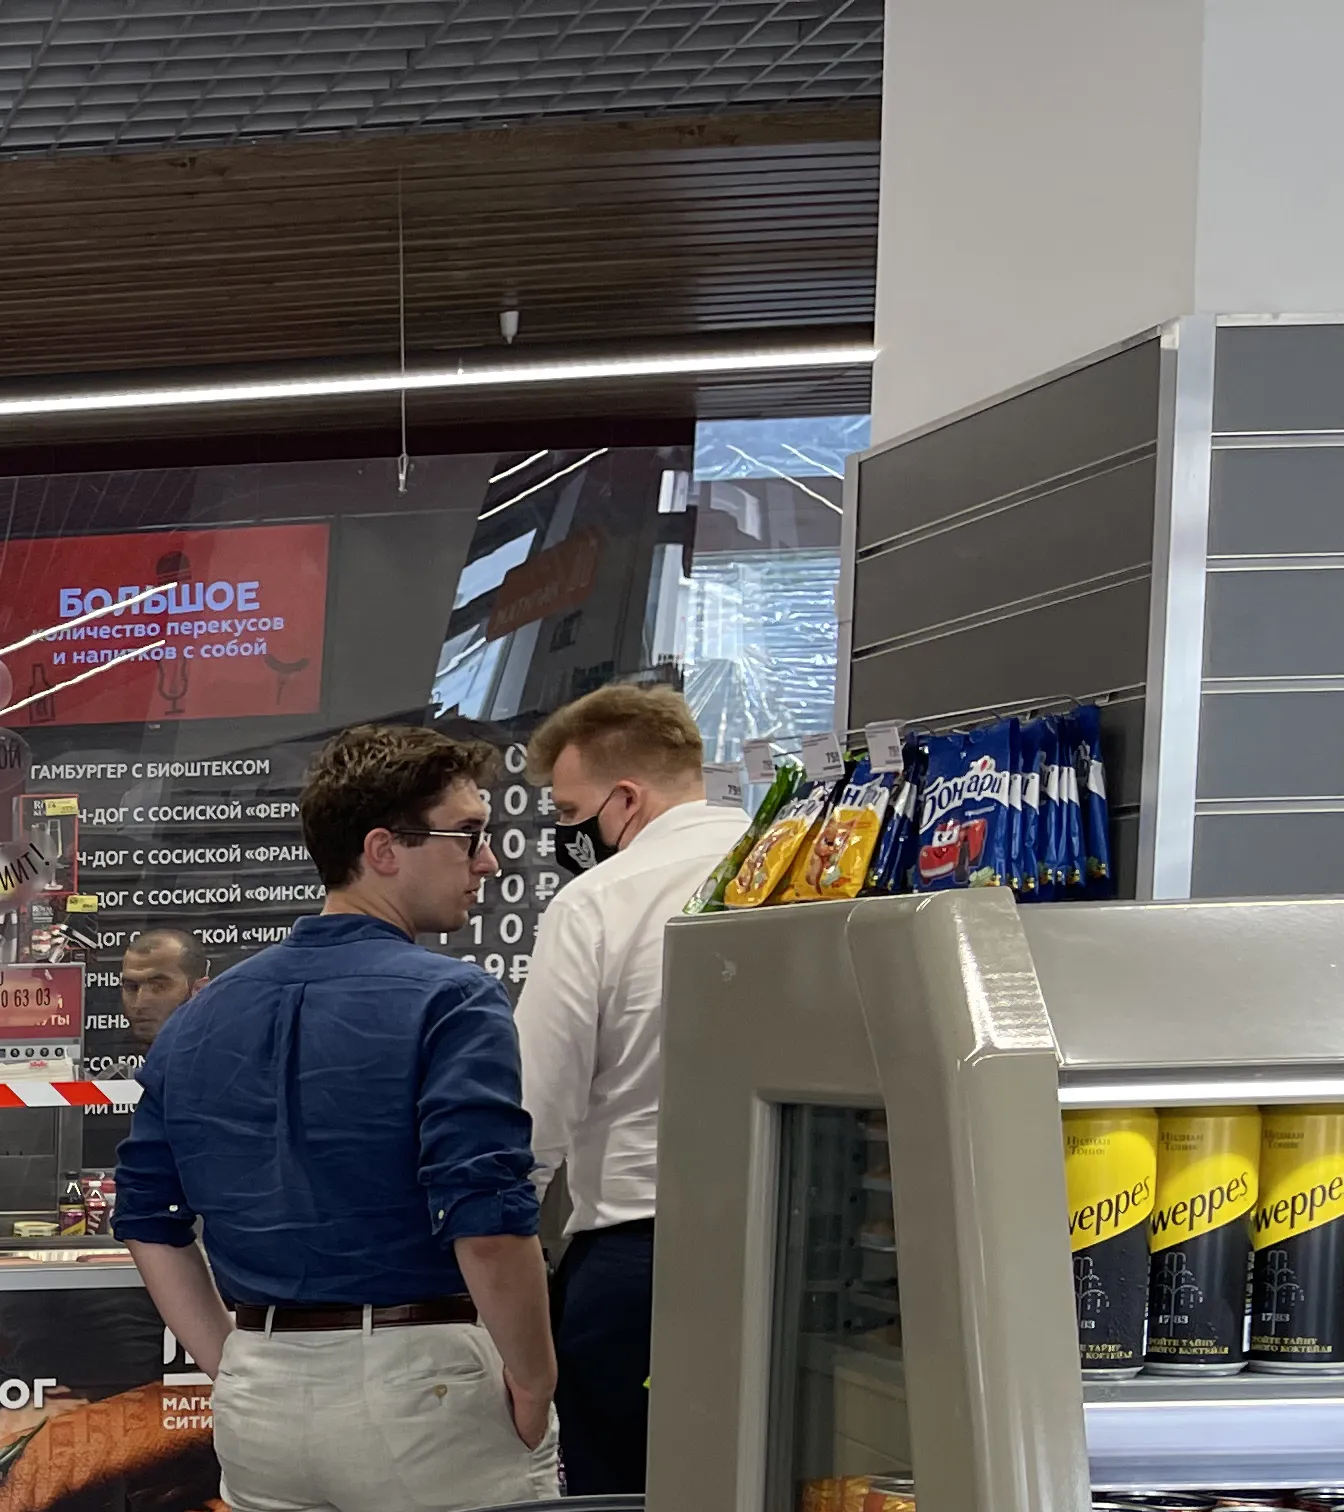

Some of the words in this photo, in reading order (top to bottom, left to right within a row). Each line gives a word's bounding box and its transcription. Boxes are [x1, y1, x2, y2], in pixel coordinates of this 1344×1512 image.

[59, 581, 260, 618] БОЛЬШОЕ
[166, 617, 285, 638] перекусов
[53, 652, 65, 665] и
[72, 646, 177, 664] напитков
[183, 645, 195, 658] с
[199, 638, 267, 657] собой
[30, 763, 128, 779] ГАМБУРГЕР
[132, 763, 143, 778] С
[147, 759, 270, 778] БИФШТЕКСОМ
[133, 806, 144, 822] С
[148, 802, 242, 822] СОСИСКОЙ
[133, 849, 144, 865] С
[148, 844, 242, 865] СОСИСКОЙ
[133, 891, 144, 905] С
[148, 885, 242, 905] СОСИСКОЙ
[14, 989, 30, 1007] 63
[36, 988, 51, 1006] 03
[1151, 1171, 1249, 1236] weppes
[163, 1416, 213, 1430] СИТИ
